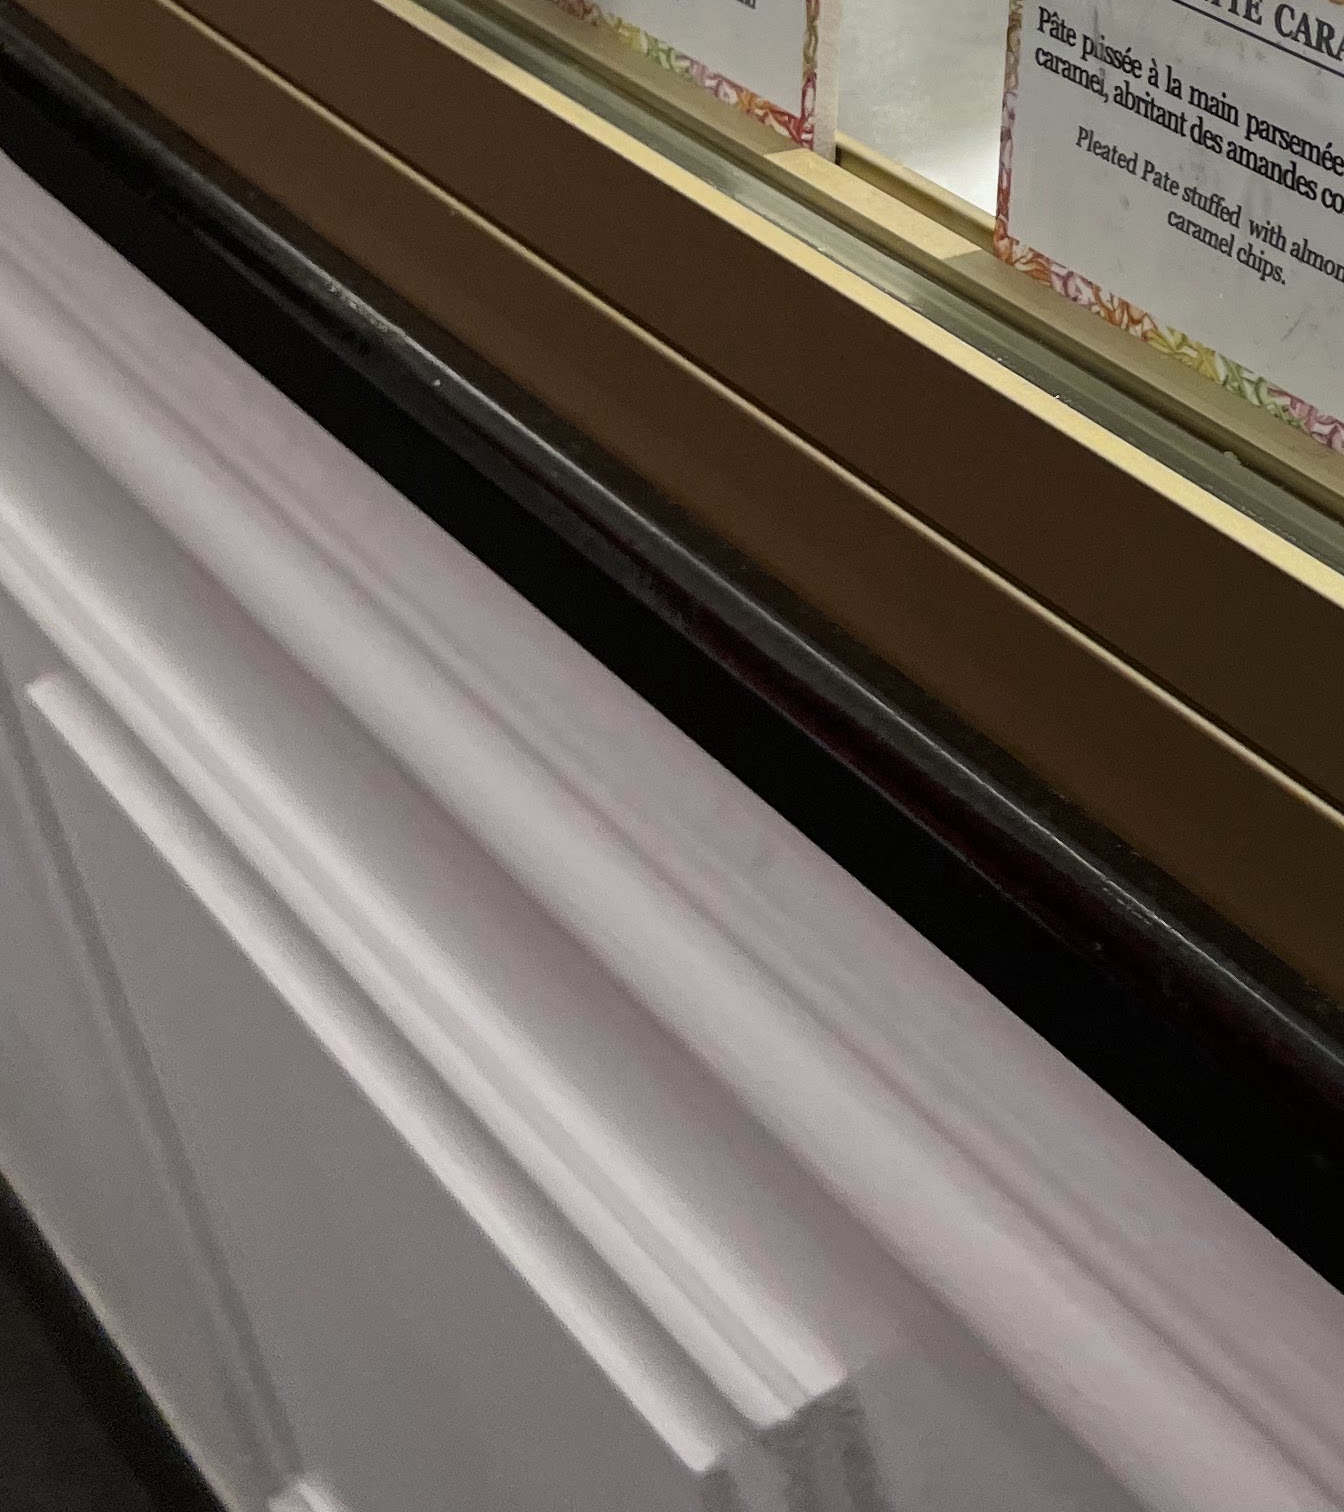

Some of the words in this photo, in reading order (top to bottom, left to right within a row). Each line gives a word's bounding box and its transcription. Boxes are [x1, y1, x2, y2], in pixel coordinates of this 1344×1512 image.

[1035, 47, 1108, 103] caramel,
[1113, 80, 1188, 137] abritant
[1190, 116, 1223, 154] des
[1226, 141, 1318, 201] amandes
[1037, 6, 1077, 47] Pâte
[1148, 58, 1159, 88] à
[1165, 64, 1182, 99] la
[1188, 85, 1240, 127] main
[1245, 113, 1344, 176] parsemée
[1076, 126, 1139, 175] Pleated
[1141, 159, 1179, 196] Pate
[1182, 186, 1242, 228] stuffed
[1248, 220, 1287, 252] with
[1168, 210, 1235, 257] caramel
[1236, 242, 1286, 285] chips.
